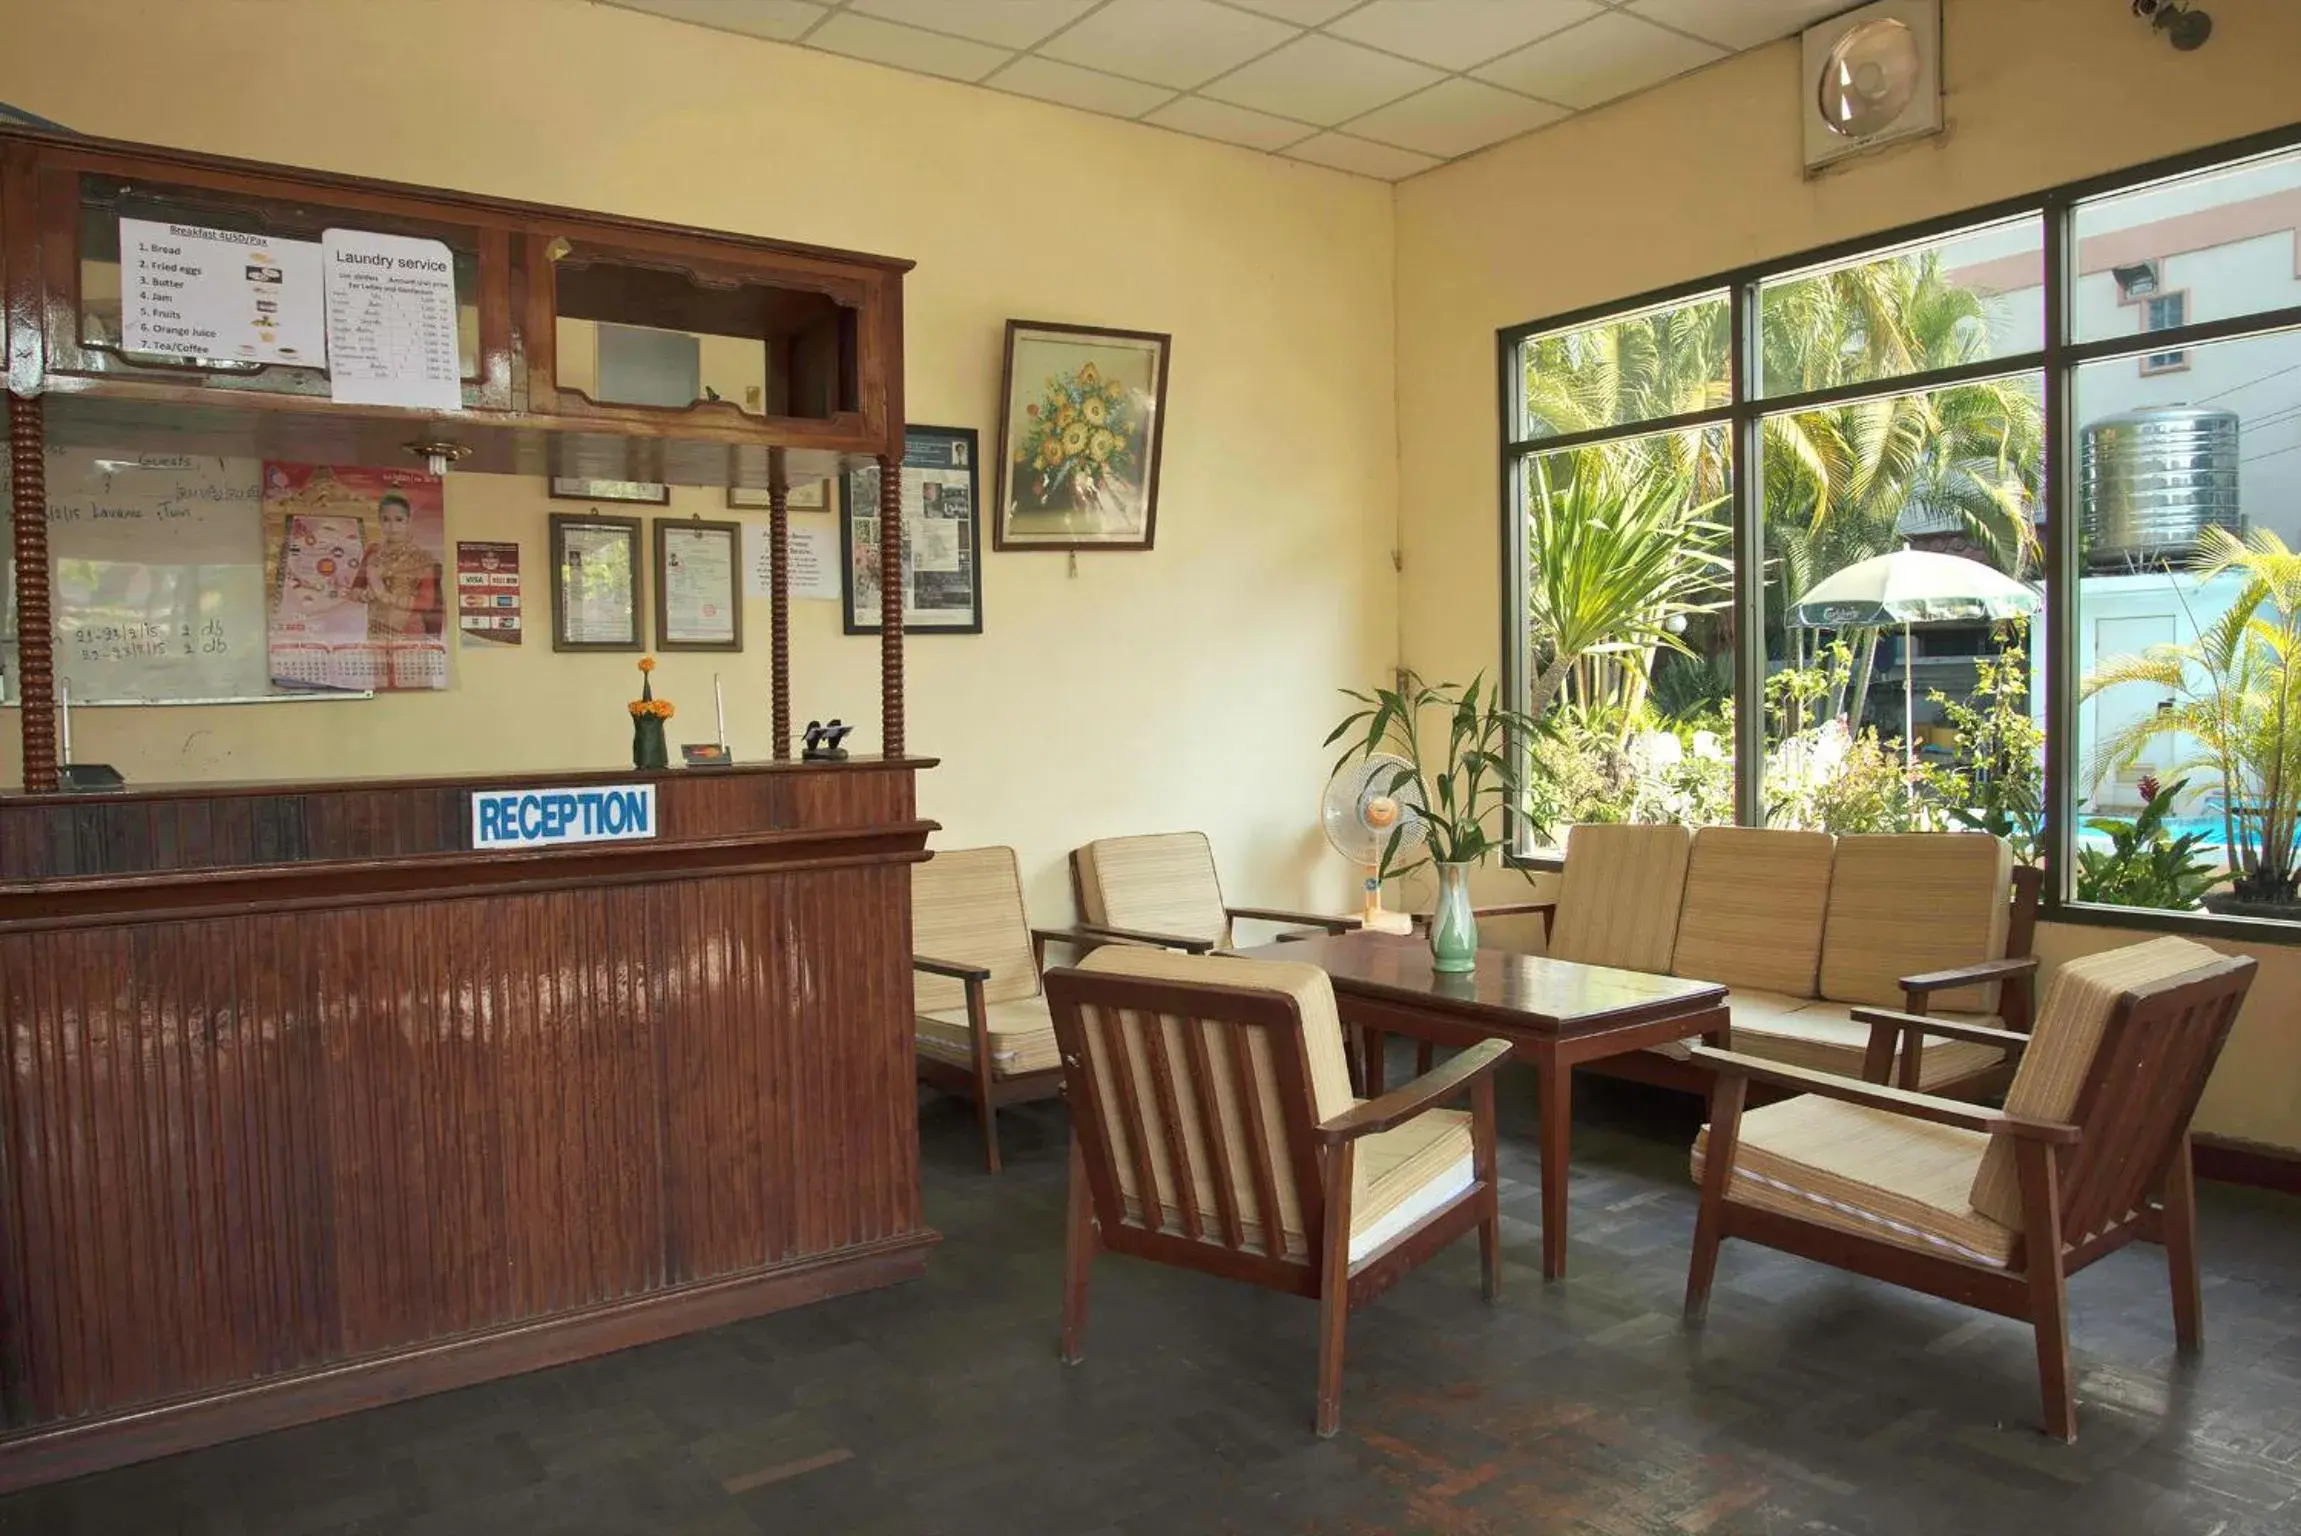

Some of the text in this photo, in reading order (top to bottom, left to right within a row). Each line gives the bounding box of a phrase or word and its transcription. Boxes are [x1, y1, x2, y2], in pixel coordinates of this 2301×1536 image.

[170, 225, 216, 239] Breakfast
[138, 243, 181, 255] 1. Bread
[336, 249, 447, 272] Laundry service
[138, 260, 202, 276] 2. Fried eggs
[140, 276, 184, 289] 3. Butter
[140, 292, 172, 302] 4. Jam
[140, 308, 181, 320] 5. Fruits
[140, 324, 150, 332] 6.
[153, 324, 189, 337] Orange
[140, 340, 209, 354] 7. Tea/Coffee
[466, 576, 484, 584] VISA
[479, 791, 648, 842] RECEPTION
